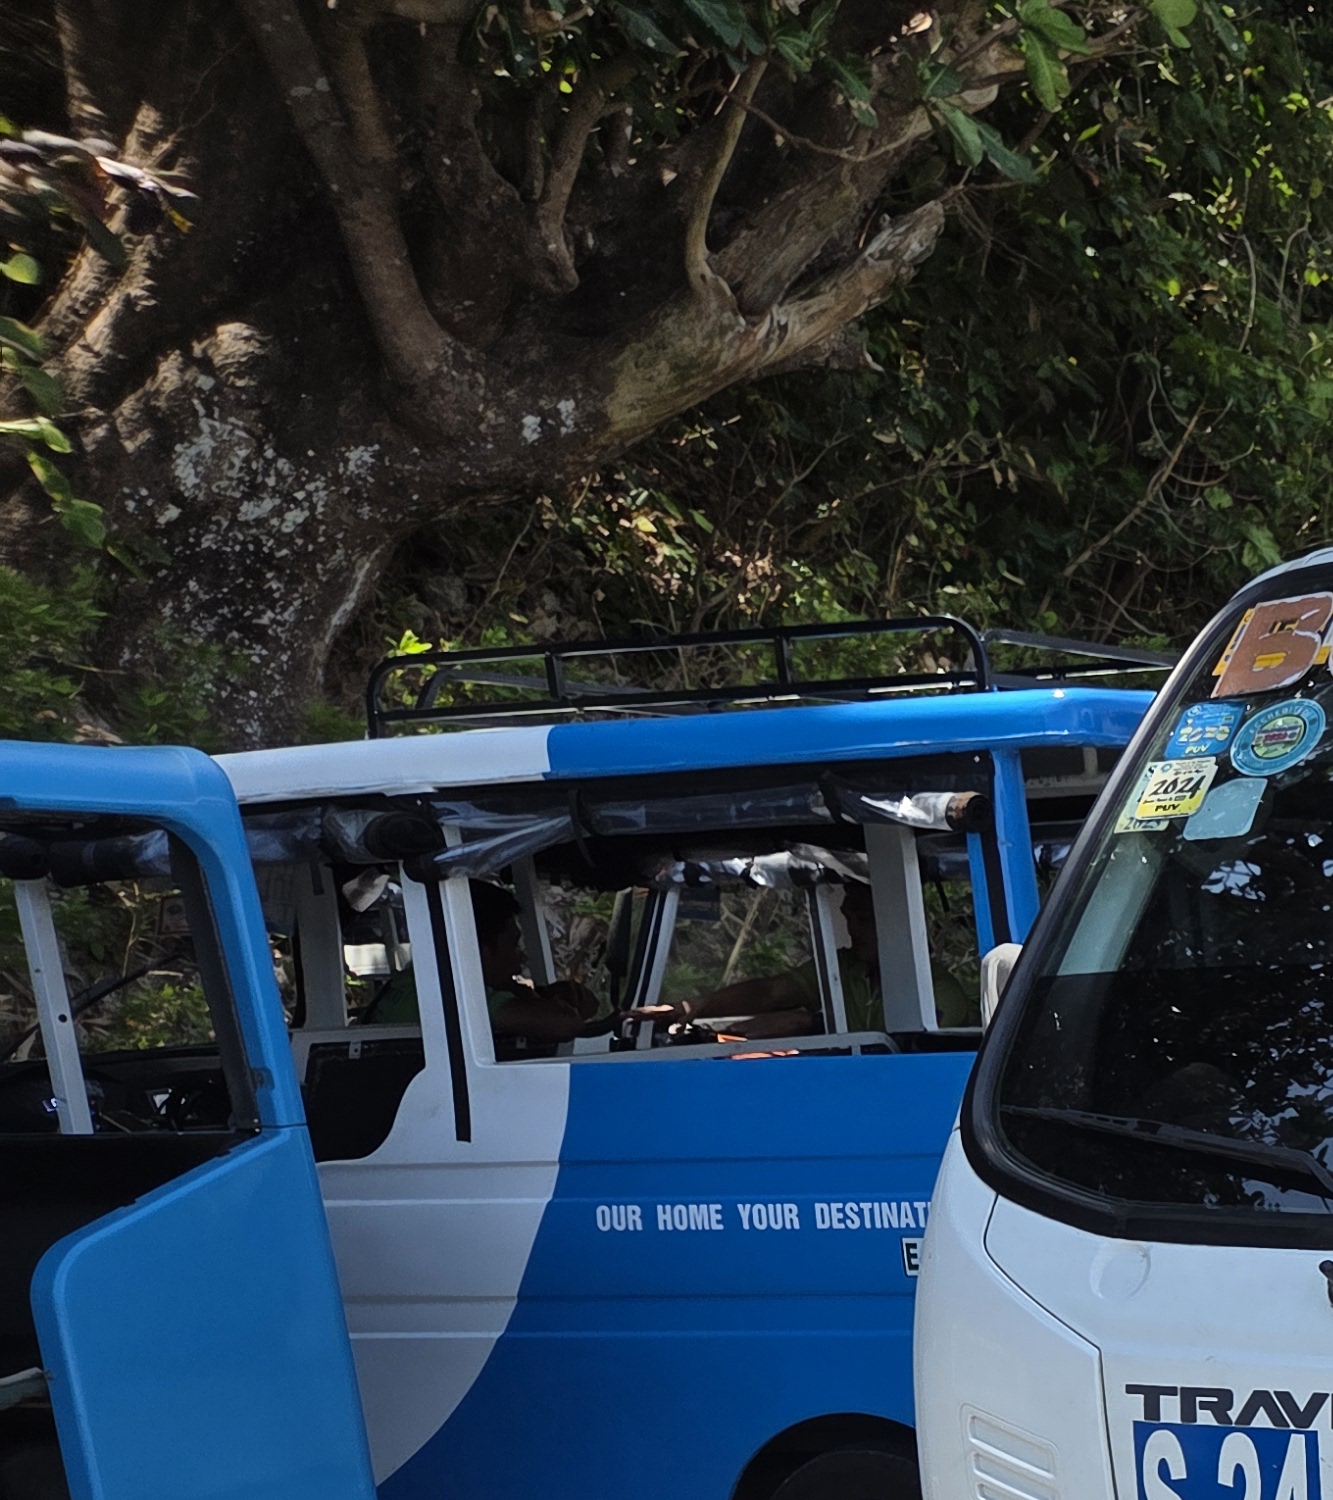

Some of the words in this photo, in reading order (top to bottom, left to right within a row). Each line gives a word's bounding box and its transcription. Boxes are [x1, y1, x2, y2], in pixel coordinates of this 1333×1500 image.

[1148, 775, 1207, 800] 2024
[1155, 804, 1181, 812] PUV
[596, 1205, 643, 1231] OUR
[656, 1204, 724, 1231] HOME
[737, 1203, 800, 1231] YOUR
